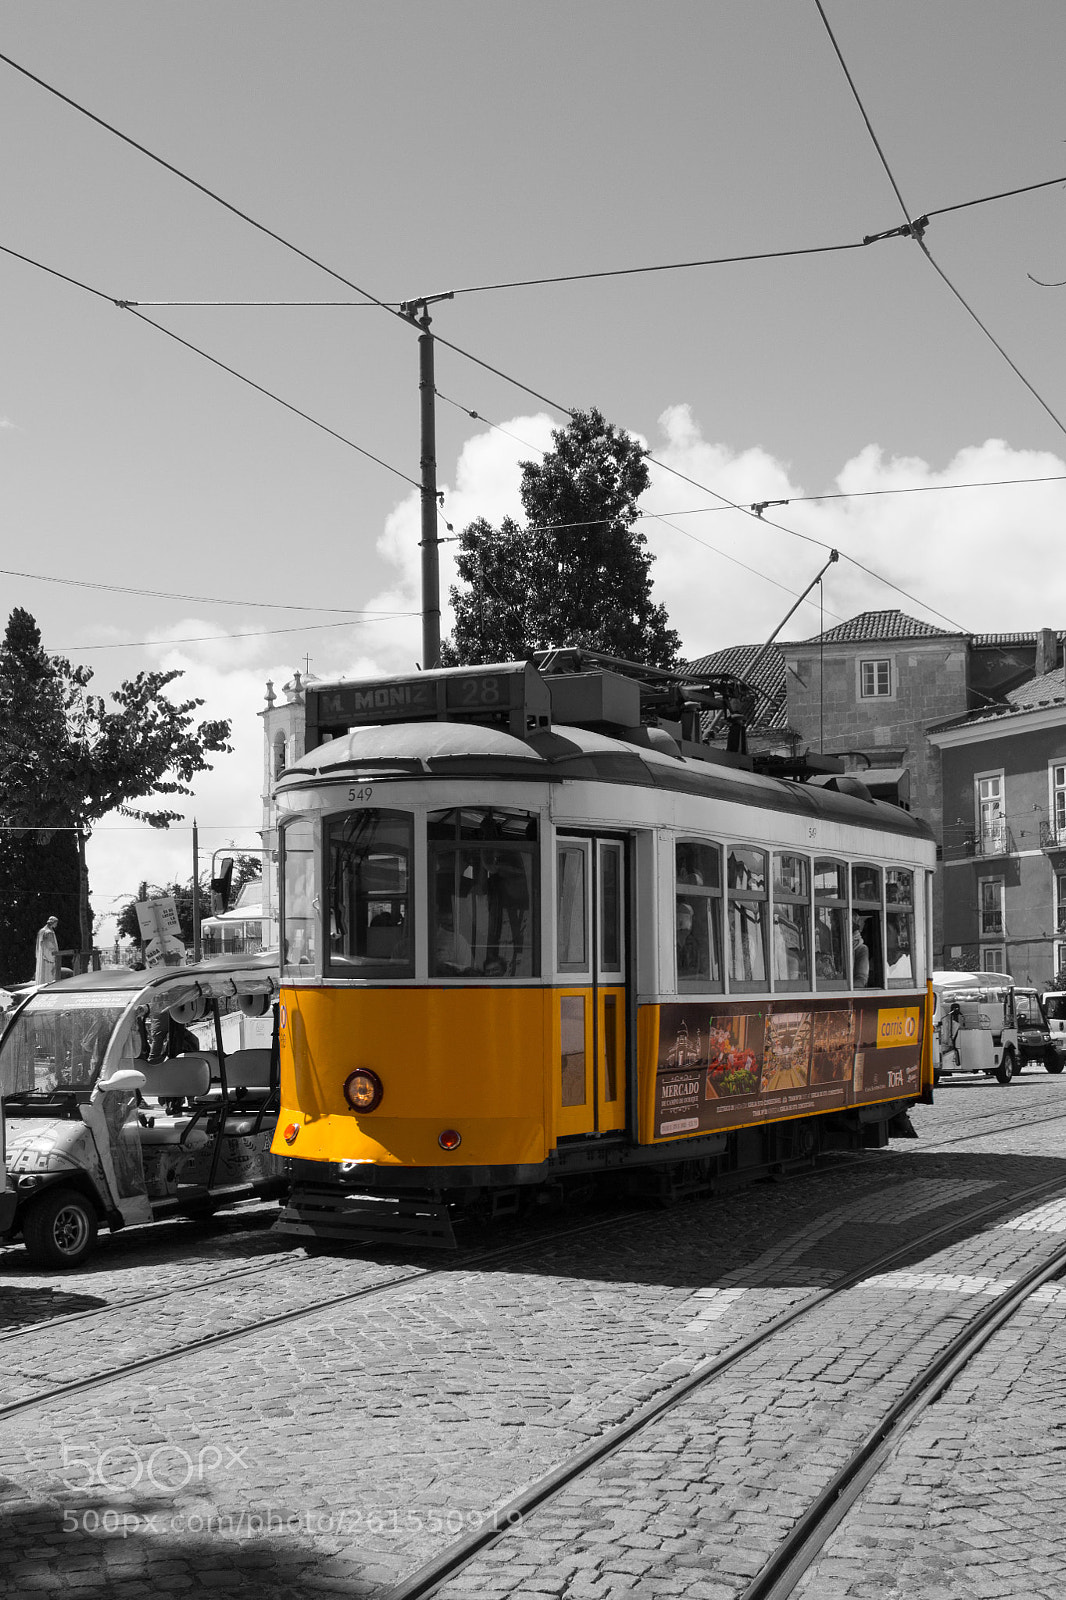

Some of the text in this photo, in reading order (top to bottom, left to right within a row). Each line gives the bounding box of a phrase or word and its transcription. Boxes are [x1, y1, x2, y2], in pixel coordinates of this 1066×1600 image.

[354, 685, 428, 710] MONIZ
[462, 678, 499, 705] 28
[348, 787, 373, 802] 549
[881, 1016, 902, 1037] carris
[888, 1069, 904, 1088] TOFA
[662, 1081, 699, 1098] MERCADO
